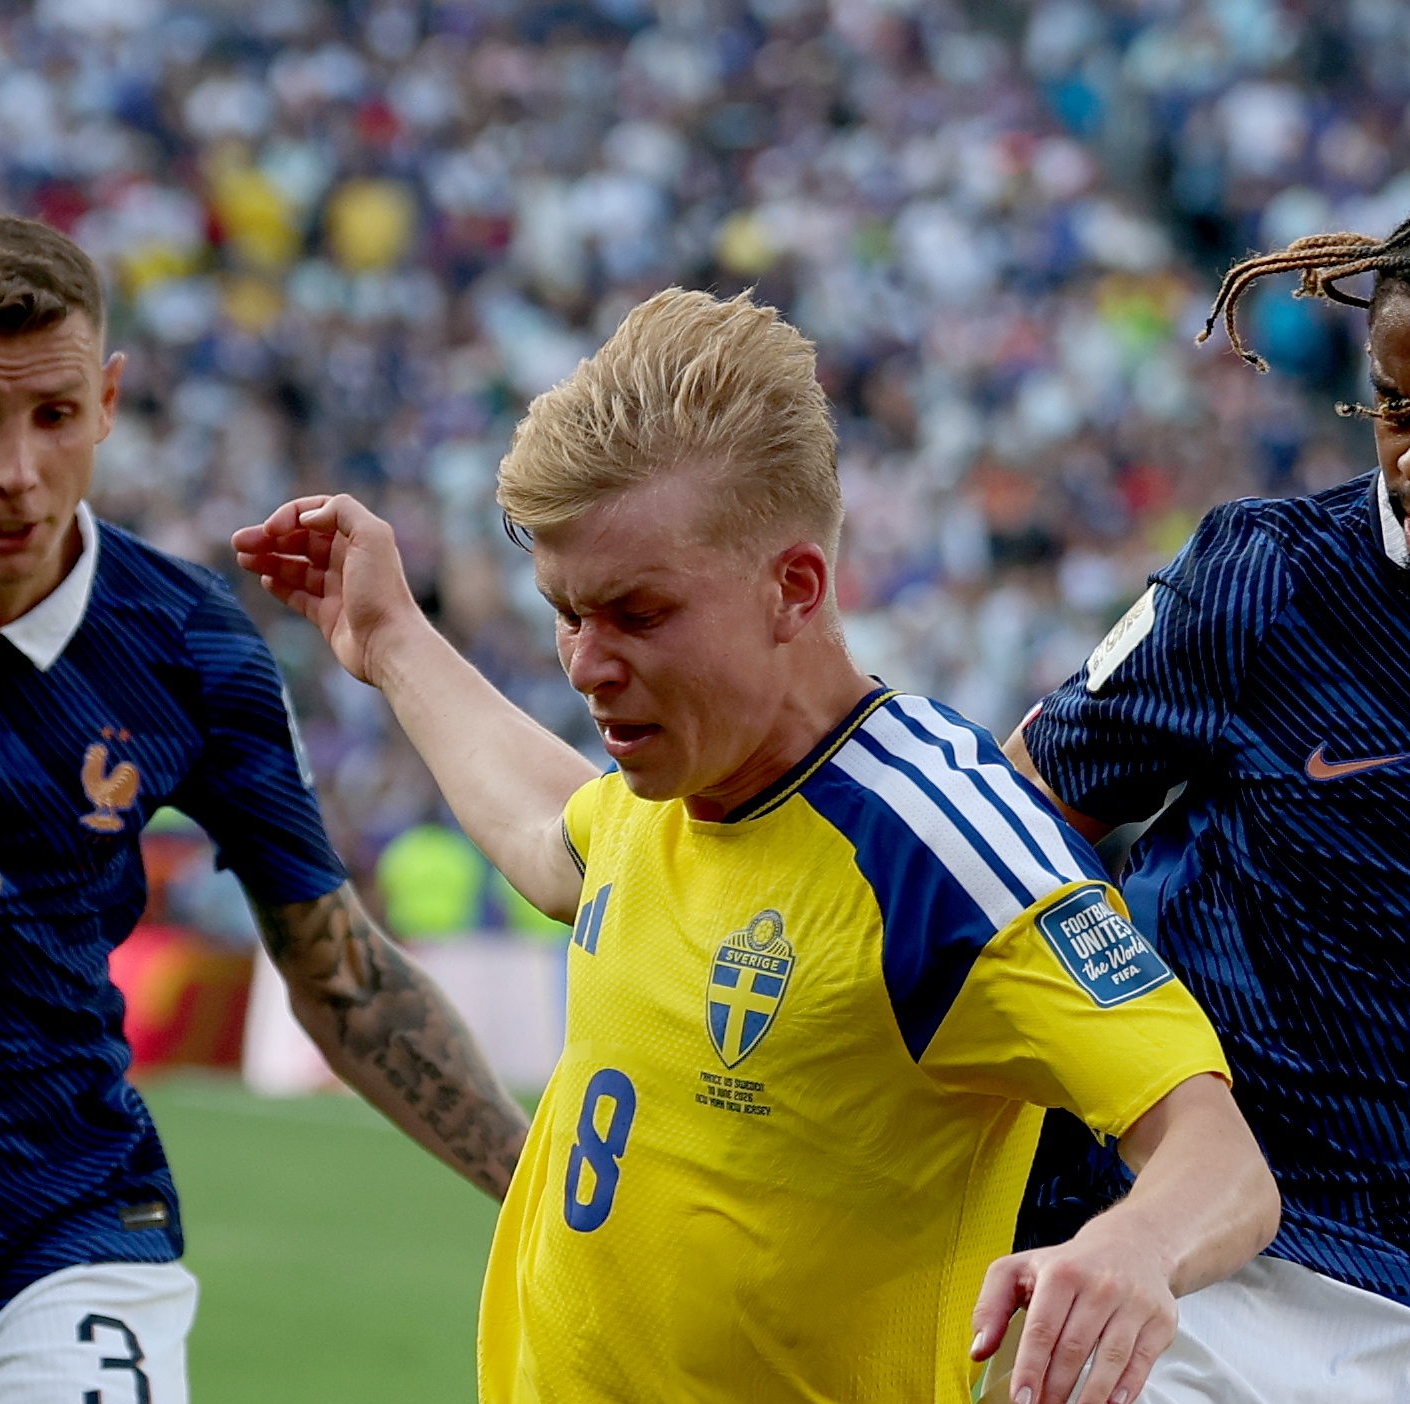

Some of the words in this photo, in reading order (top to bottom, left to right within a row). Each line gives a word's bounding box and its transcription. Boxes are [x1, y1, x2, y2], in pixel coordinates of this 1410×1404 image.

[1070, 915, 1133, 960] UNITES
[1082, 958, 1110, 982] the
[1104, 936, 1149, 970] World
[724, 949, 780, 972] SVERIGE
[1110, 964, 1141, 986] FIFA
[563, 1068, 636, 1233] 8
